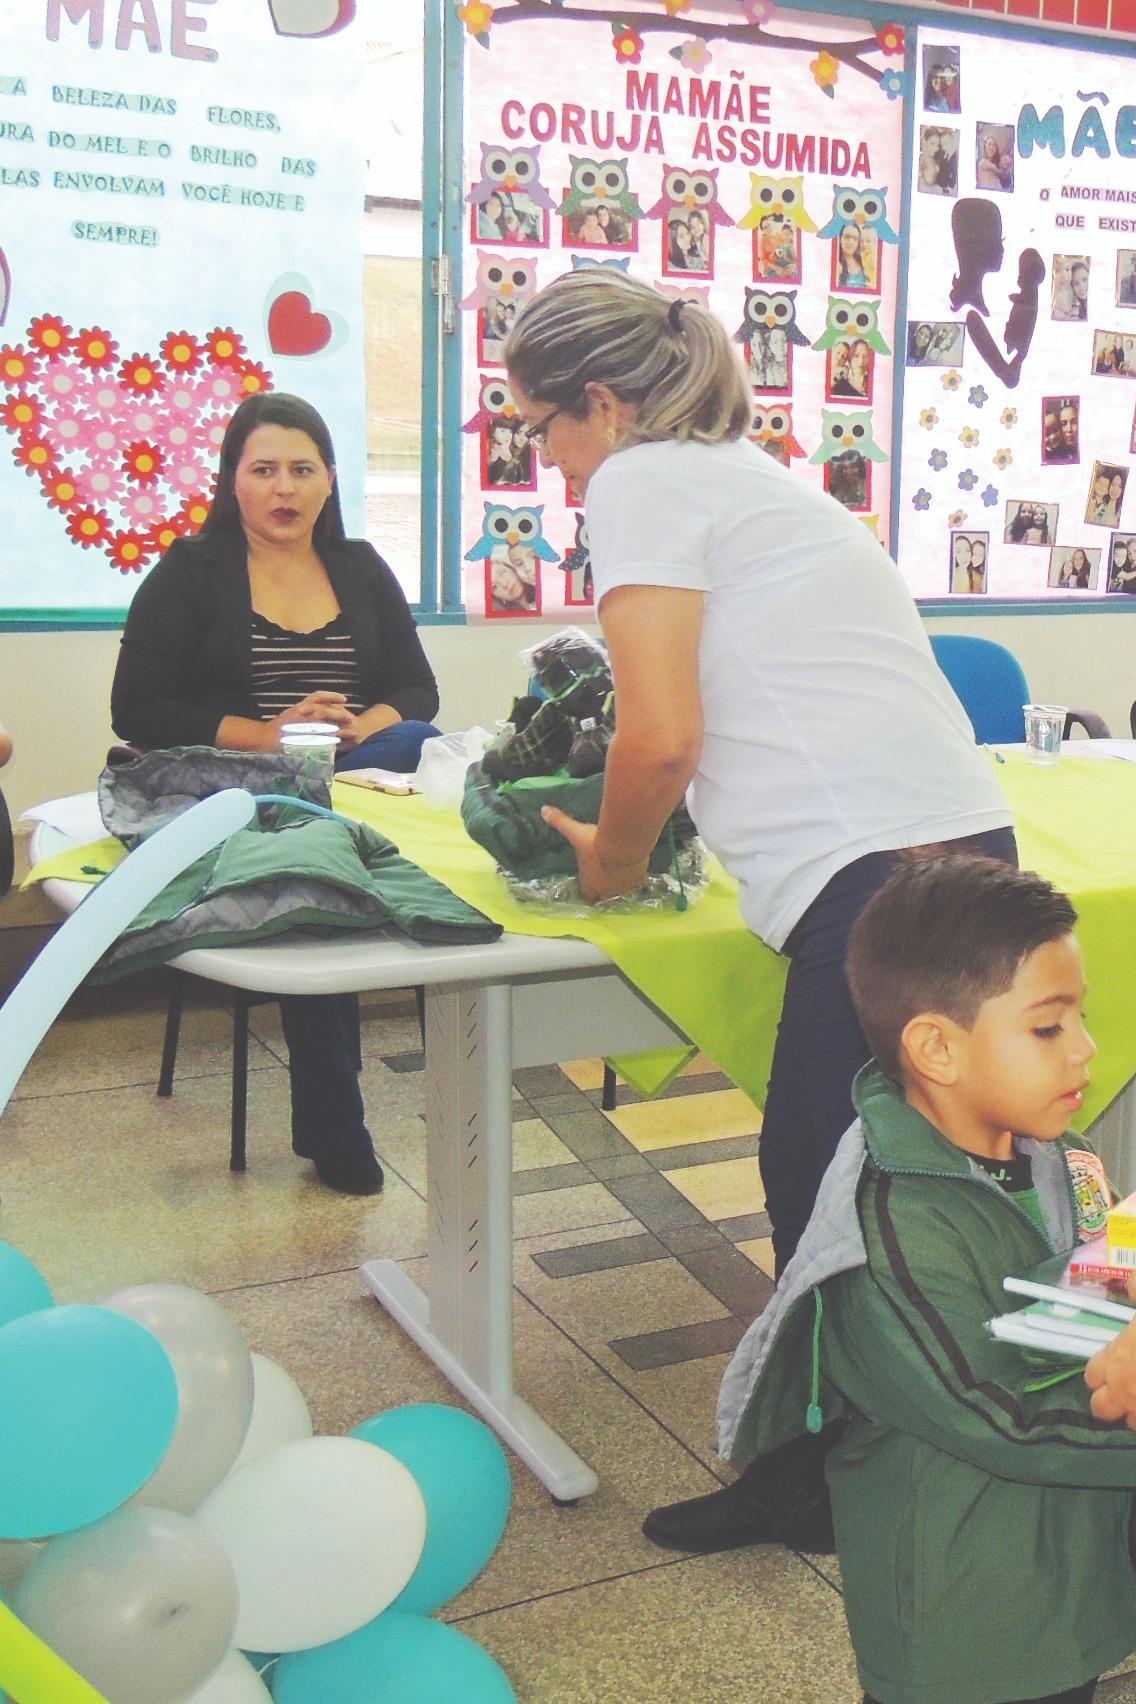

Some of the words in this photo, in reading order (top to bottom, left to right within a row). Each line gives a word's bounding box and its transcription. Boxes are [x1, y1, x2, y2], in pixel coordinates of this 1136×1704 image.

[12, 79, 27, 96] A
[52, 85, 129, 110] BELEZA
[139, 95, 177, 115] DAS
[626, 70, 771, 124] MAMÃE
[49, 131, 76, 148] DO
[87, 137, 128, 154] MEL
[138, 140, 148, 156] E
[158, 143, 171, 158] O
[190, 146, 257, 168] BRILHO
[281, 157, 317, 176] DAS
[501, 100, 665, 155] CORUJA
[692, 122, 872, 179] ASSUMIDA
[53, 171, 165, 196] ENVOLVAM
[182, 183, 232, 204] VOCÊ
[241, 190, 285, 209] HOJE
[295, 195, 304, 212] E
[1040, 189, 1049, 200] O
[1061, 186, 1100, 200] AMOR
[74, 221, 157, 246] SEMPRE!
[1056, 214, 1085, 228] QUE
